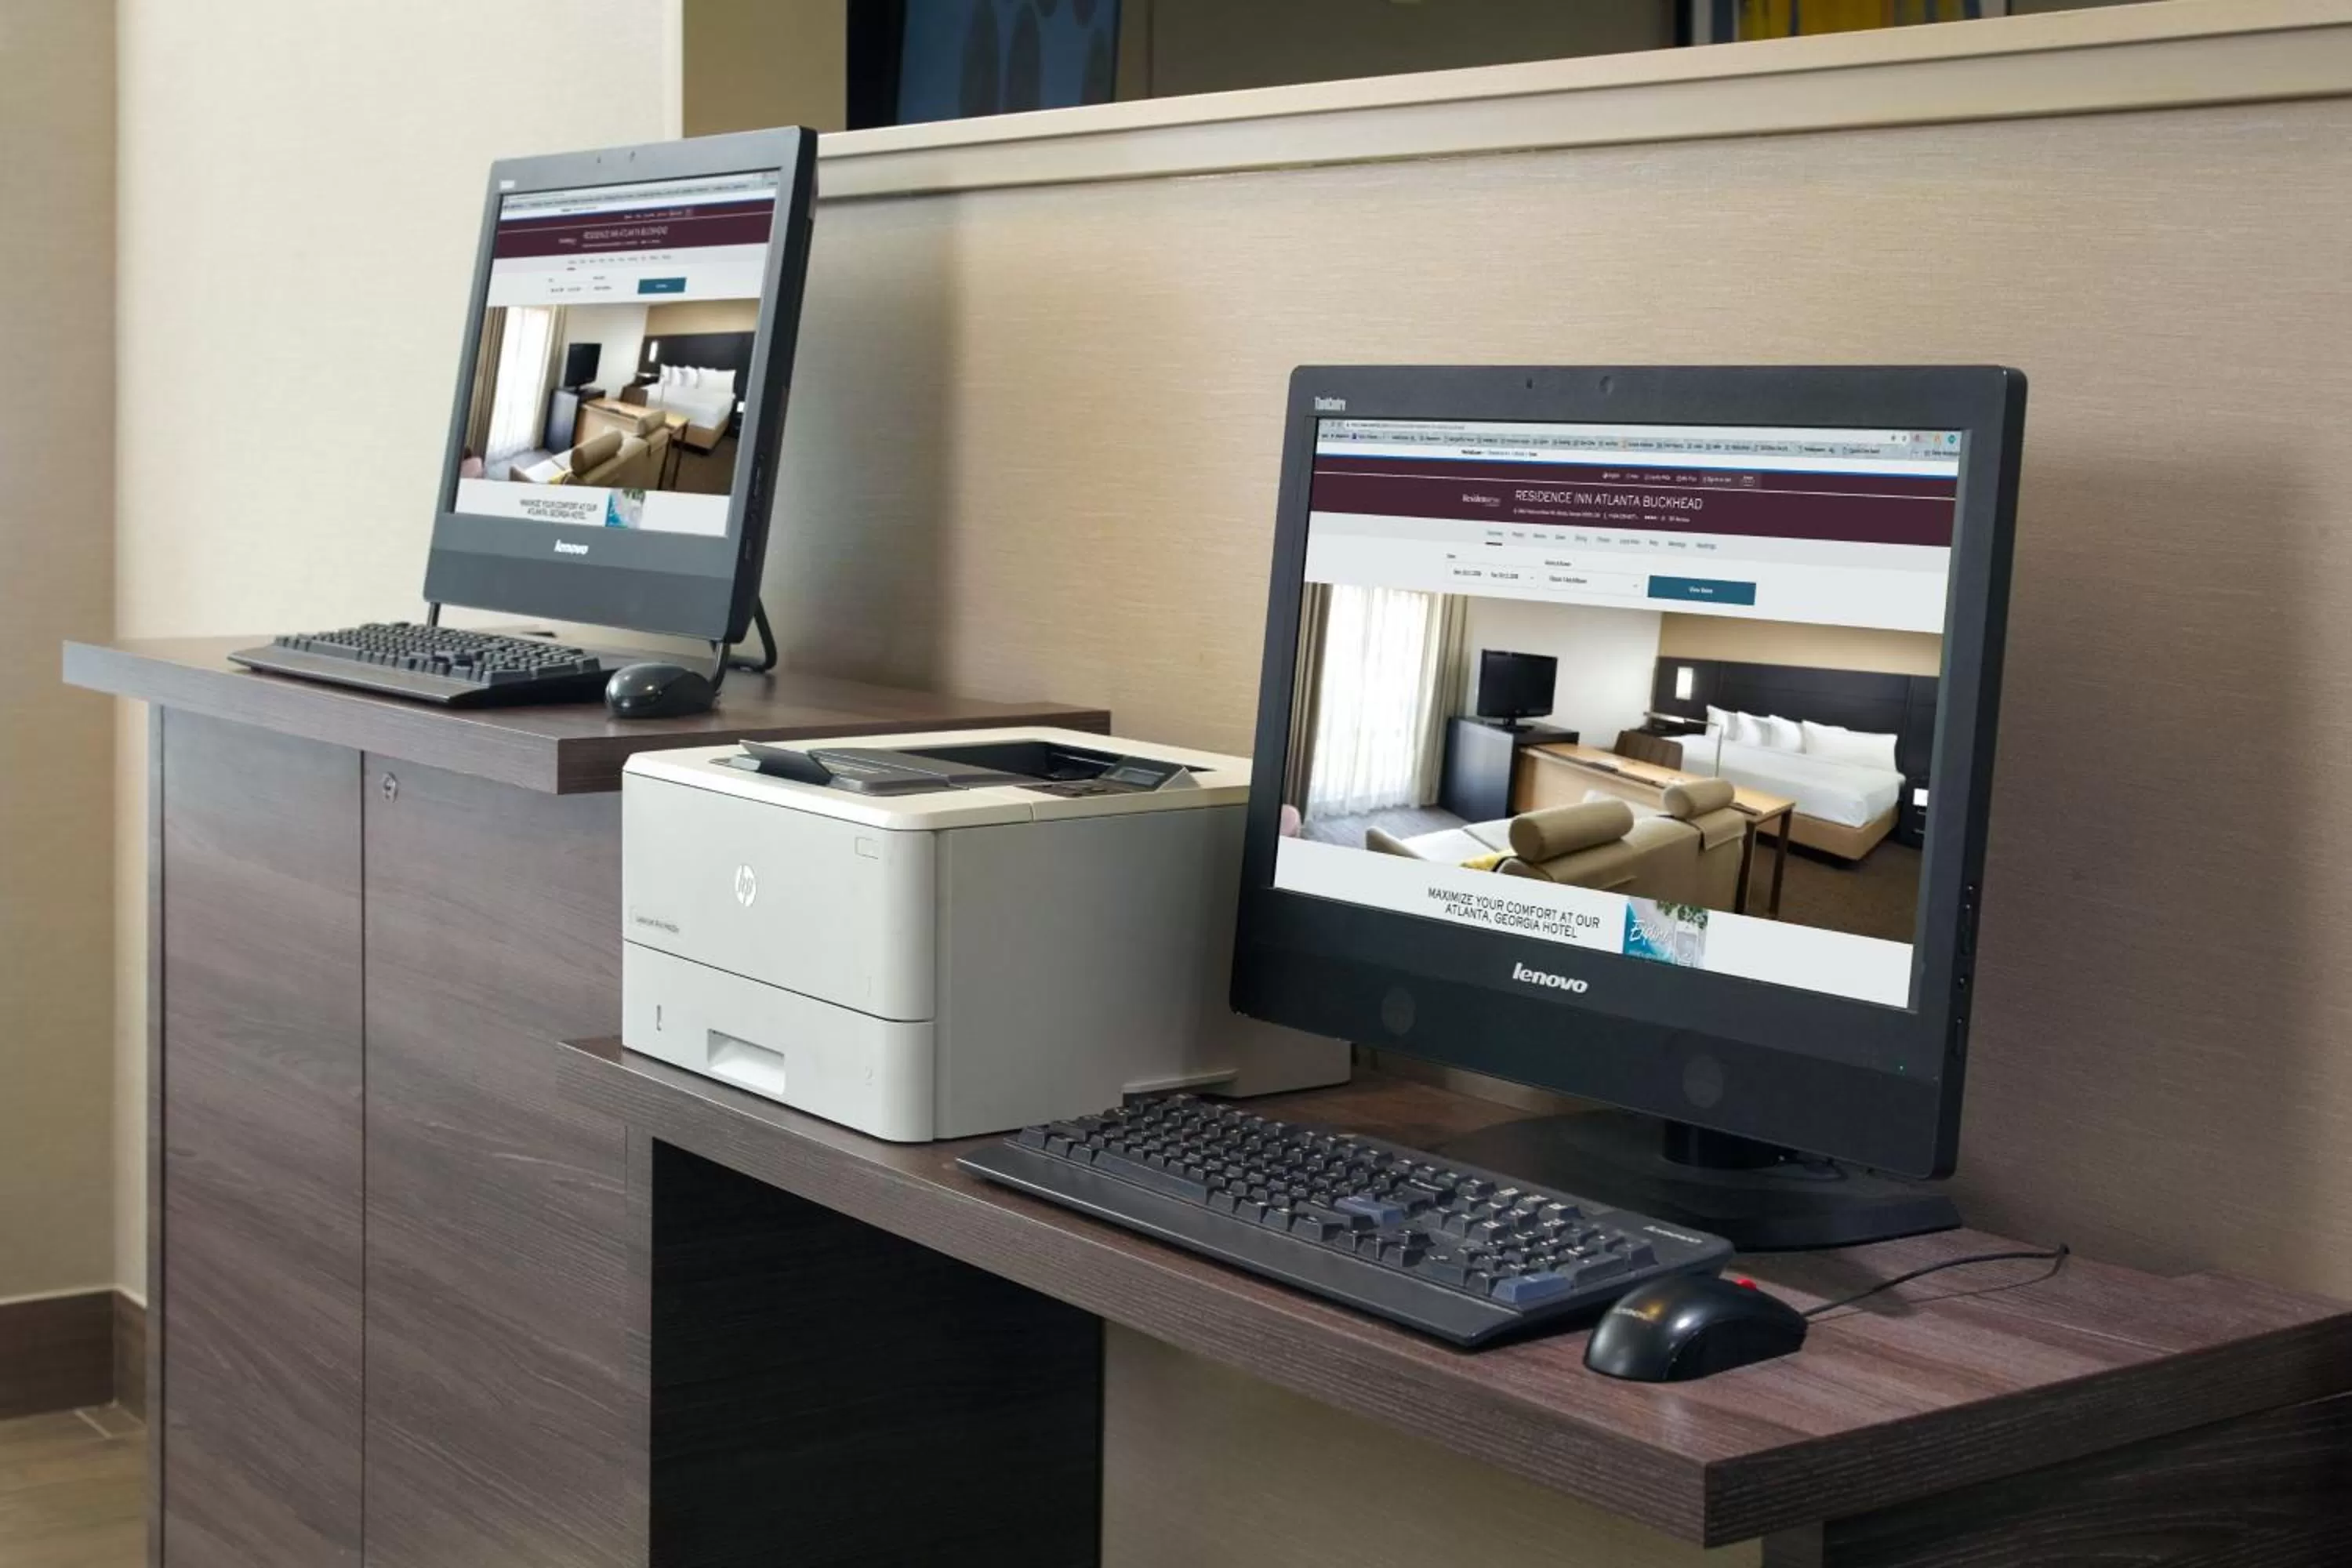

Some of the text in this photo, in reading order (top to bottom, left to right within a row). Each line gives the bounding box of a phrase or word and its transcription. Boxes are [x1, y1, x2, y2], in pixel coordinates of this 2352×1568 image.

[1515, 490, 1572, 503] RESIDENCE
[1573, 493, 1593, 504] INN
[1595, 493, 1641, 506] ATLANTA
[1642, 495, 1703, 510] BUCKHEAD
[554, 539, 589, 555] lenovo
[1428, 887, 1601, 929] MAXIMIZE YOUR COMFORT AT OUR
[1445, 903, 1578, 938] ATLANTA, GEORGIA HOTEL
[1512, 961, 1588, 994] lenovo
